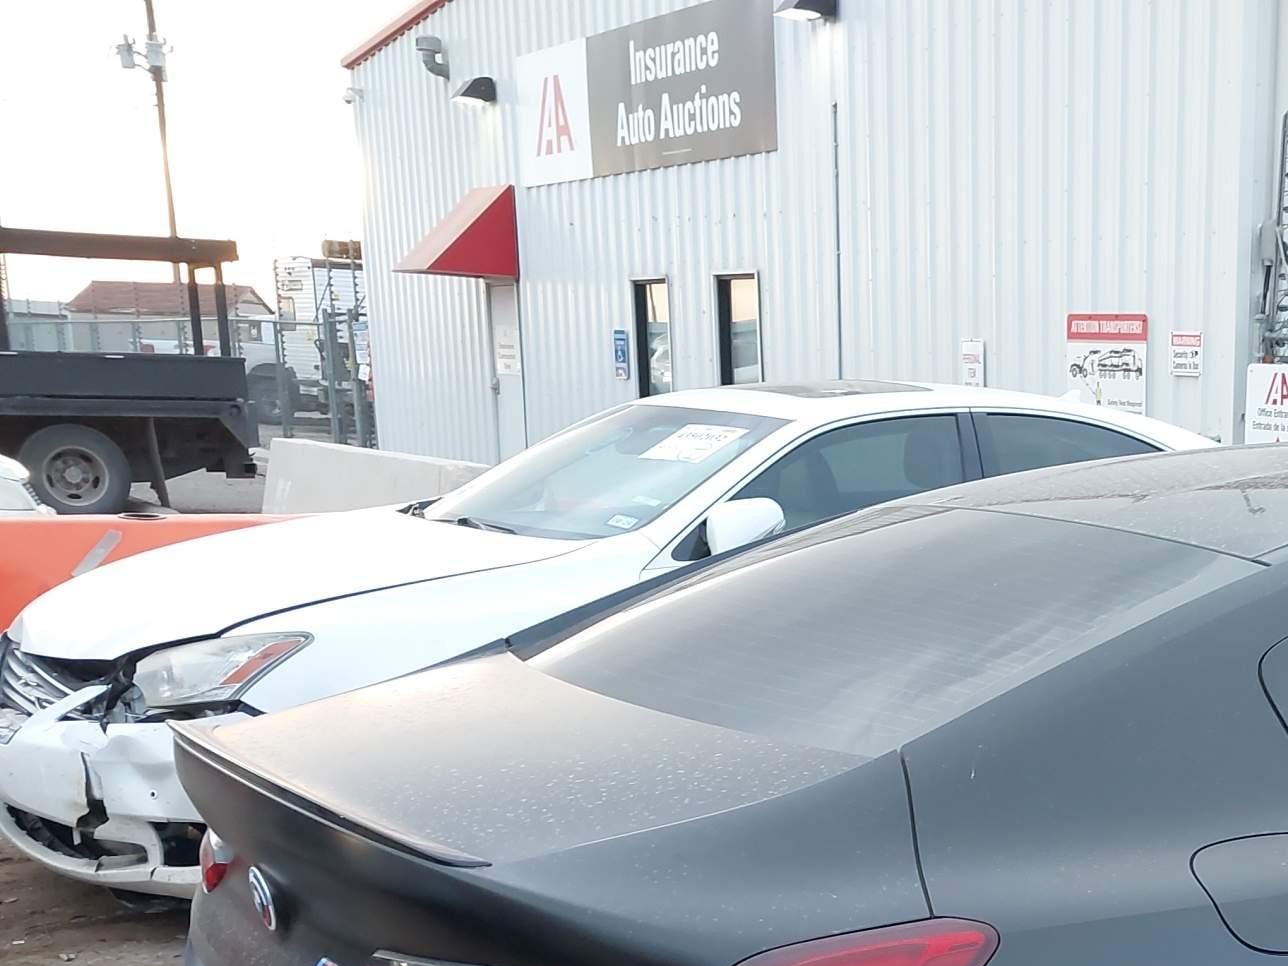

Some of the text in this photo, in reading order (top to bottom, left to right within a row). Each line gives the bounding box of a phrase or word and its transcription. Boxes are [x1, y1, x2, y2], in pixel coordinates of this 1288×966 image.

[629, 31, 719, 85] Insurance
[616, 84, 741, 147] Auto Auctions
